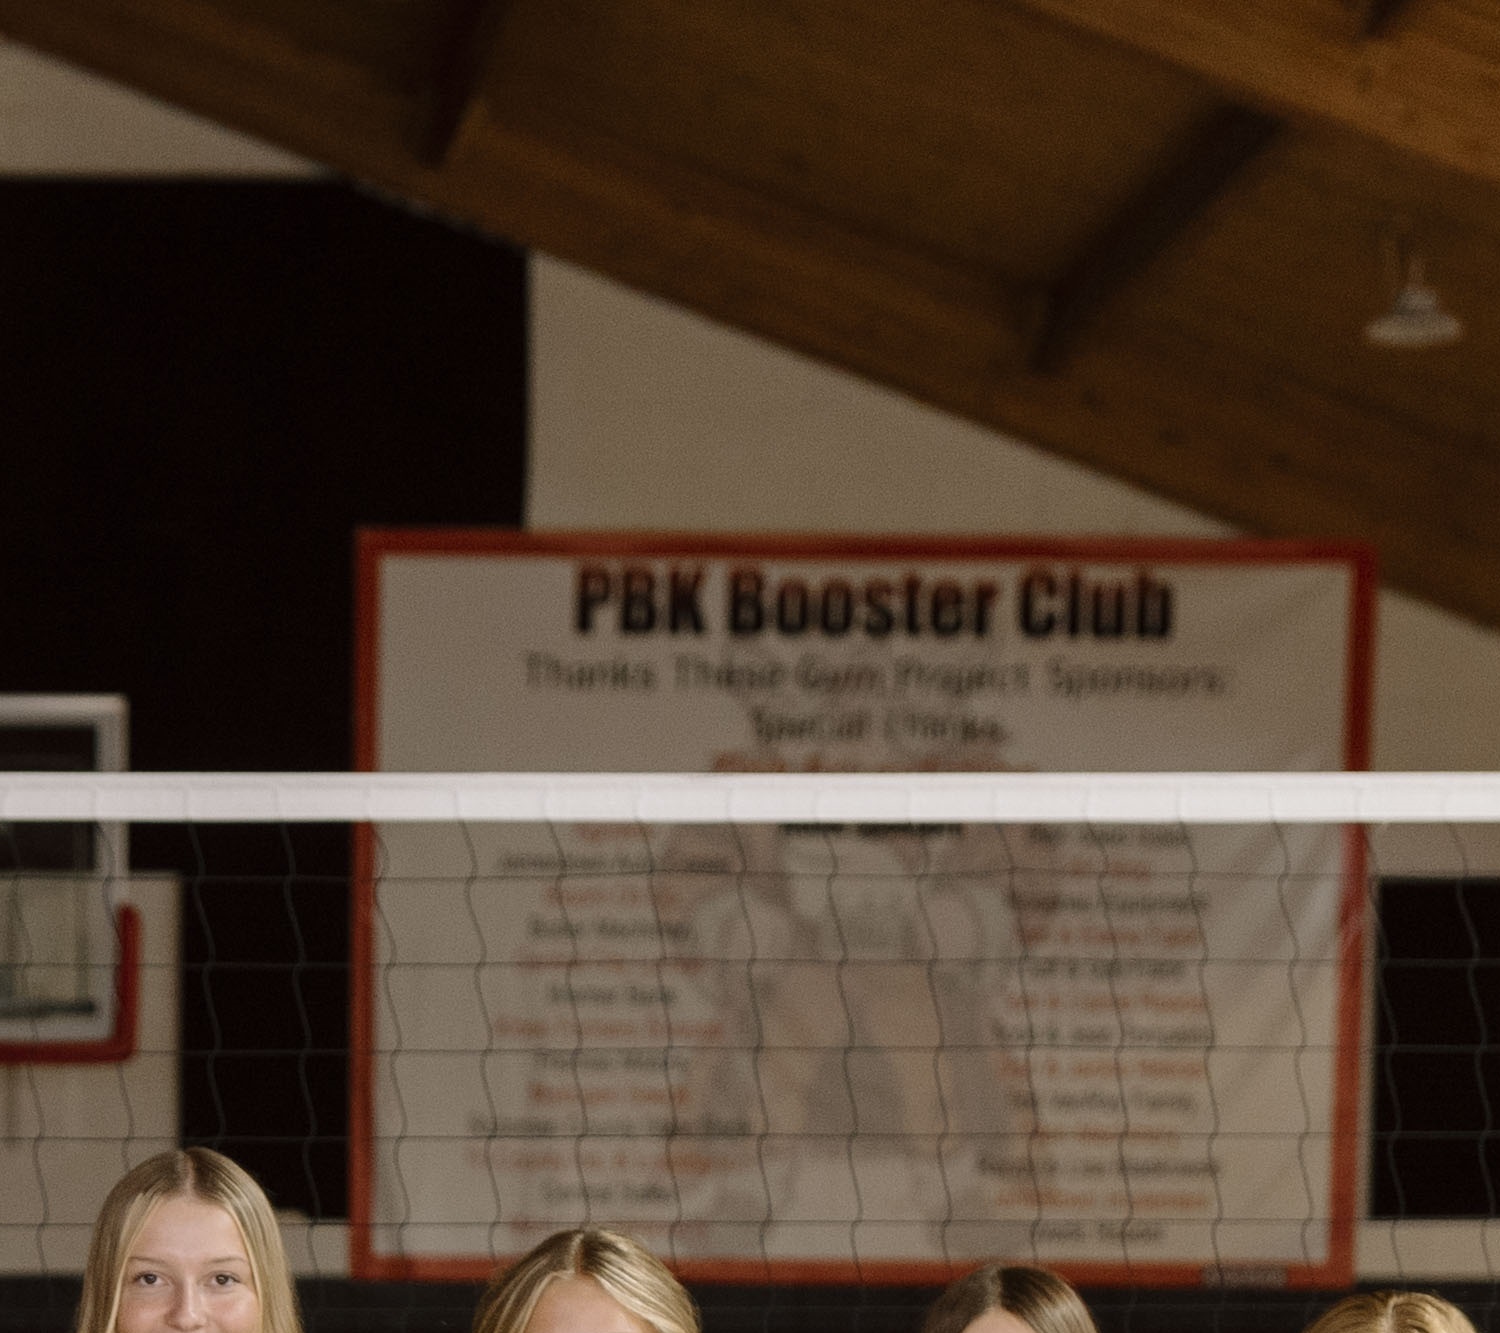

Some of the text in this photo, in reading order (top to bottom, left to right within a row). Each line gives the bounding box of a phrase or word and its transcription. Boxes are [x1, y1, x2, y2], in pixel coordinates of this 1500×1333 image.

[576, 563, 1174, 640] PBK Booster Club
